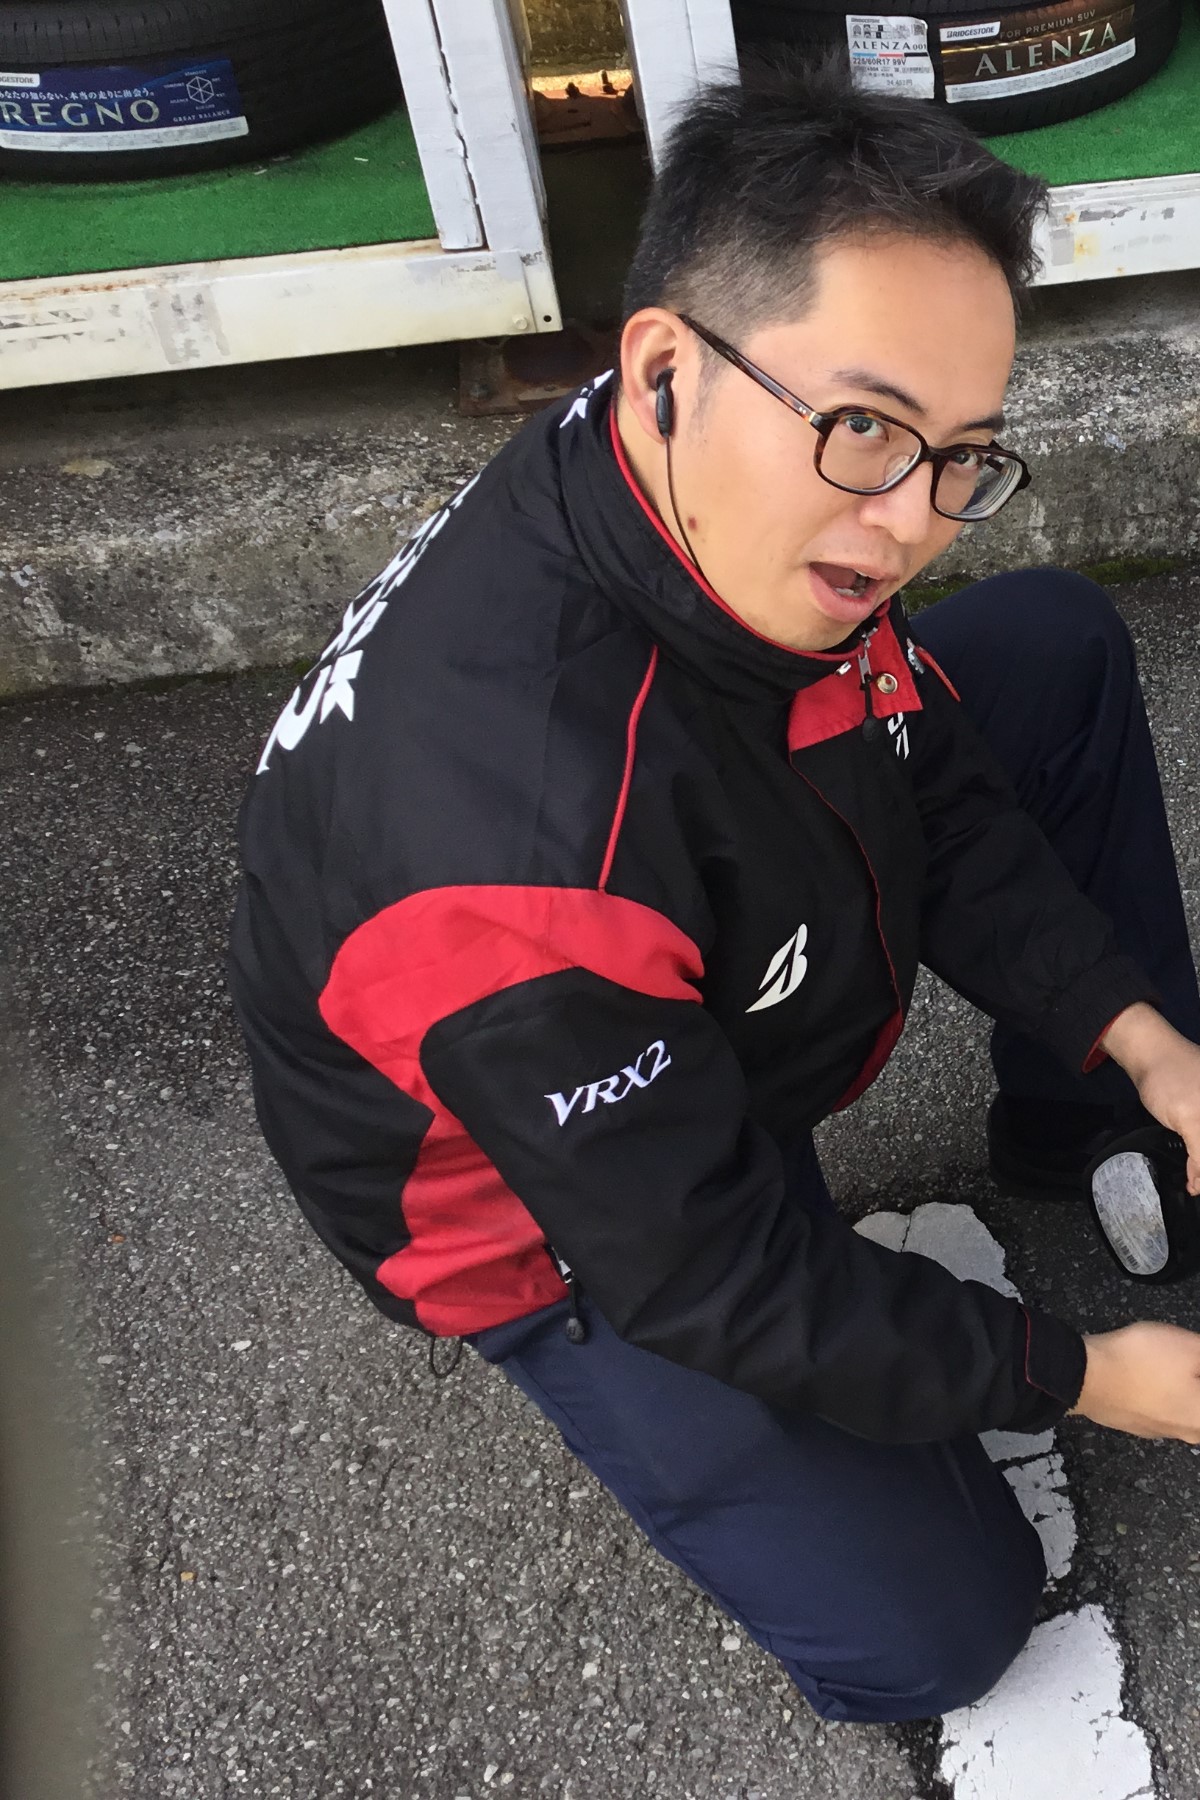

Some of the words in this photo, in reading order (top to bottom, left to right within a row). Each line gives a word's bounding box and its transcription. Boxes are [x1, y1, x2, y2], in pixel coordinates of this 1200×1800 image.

[946, 25, 995, 39] BRIDGESTONE
[1001, 30, 1021, 39] FOR
[1025, 16, 1074, 35] PREMIUM
[1077, 9, 1096, 22] SUV
[852, 41, 911, 50] ALENZA
[974, 22, 1118, 77] ALENZA
[0, 99, 159, 126] REGNO
[544, 1039, 672, 1127] VRX2
